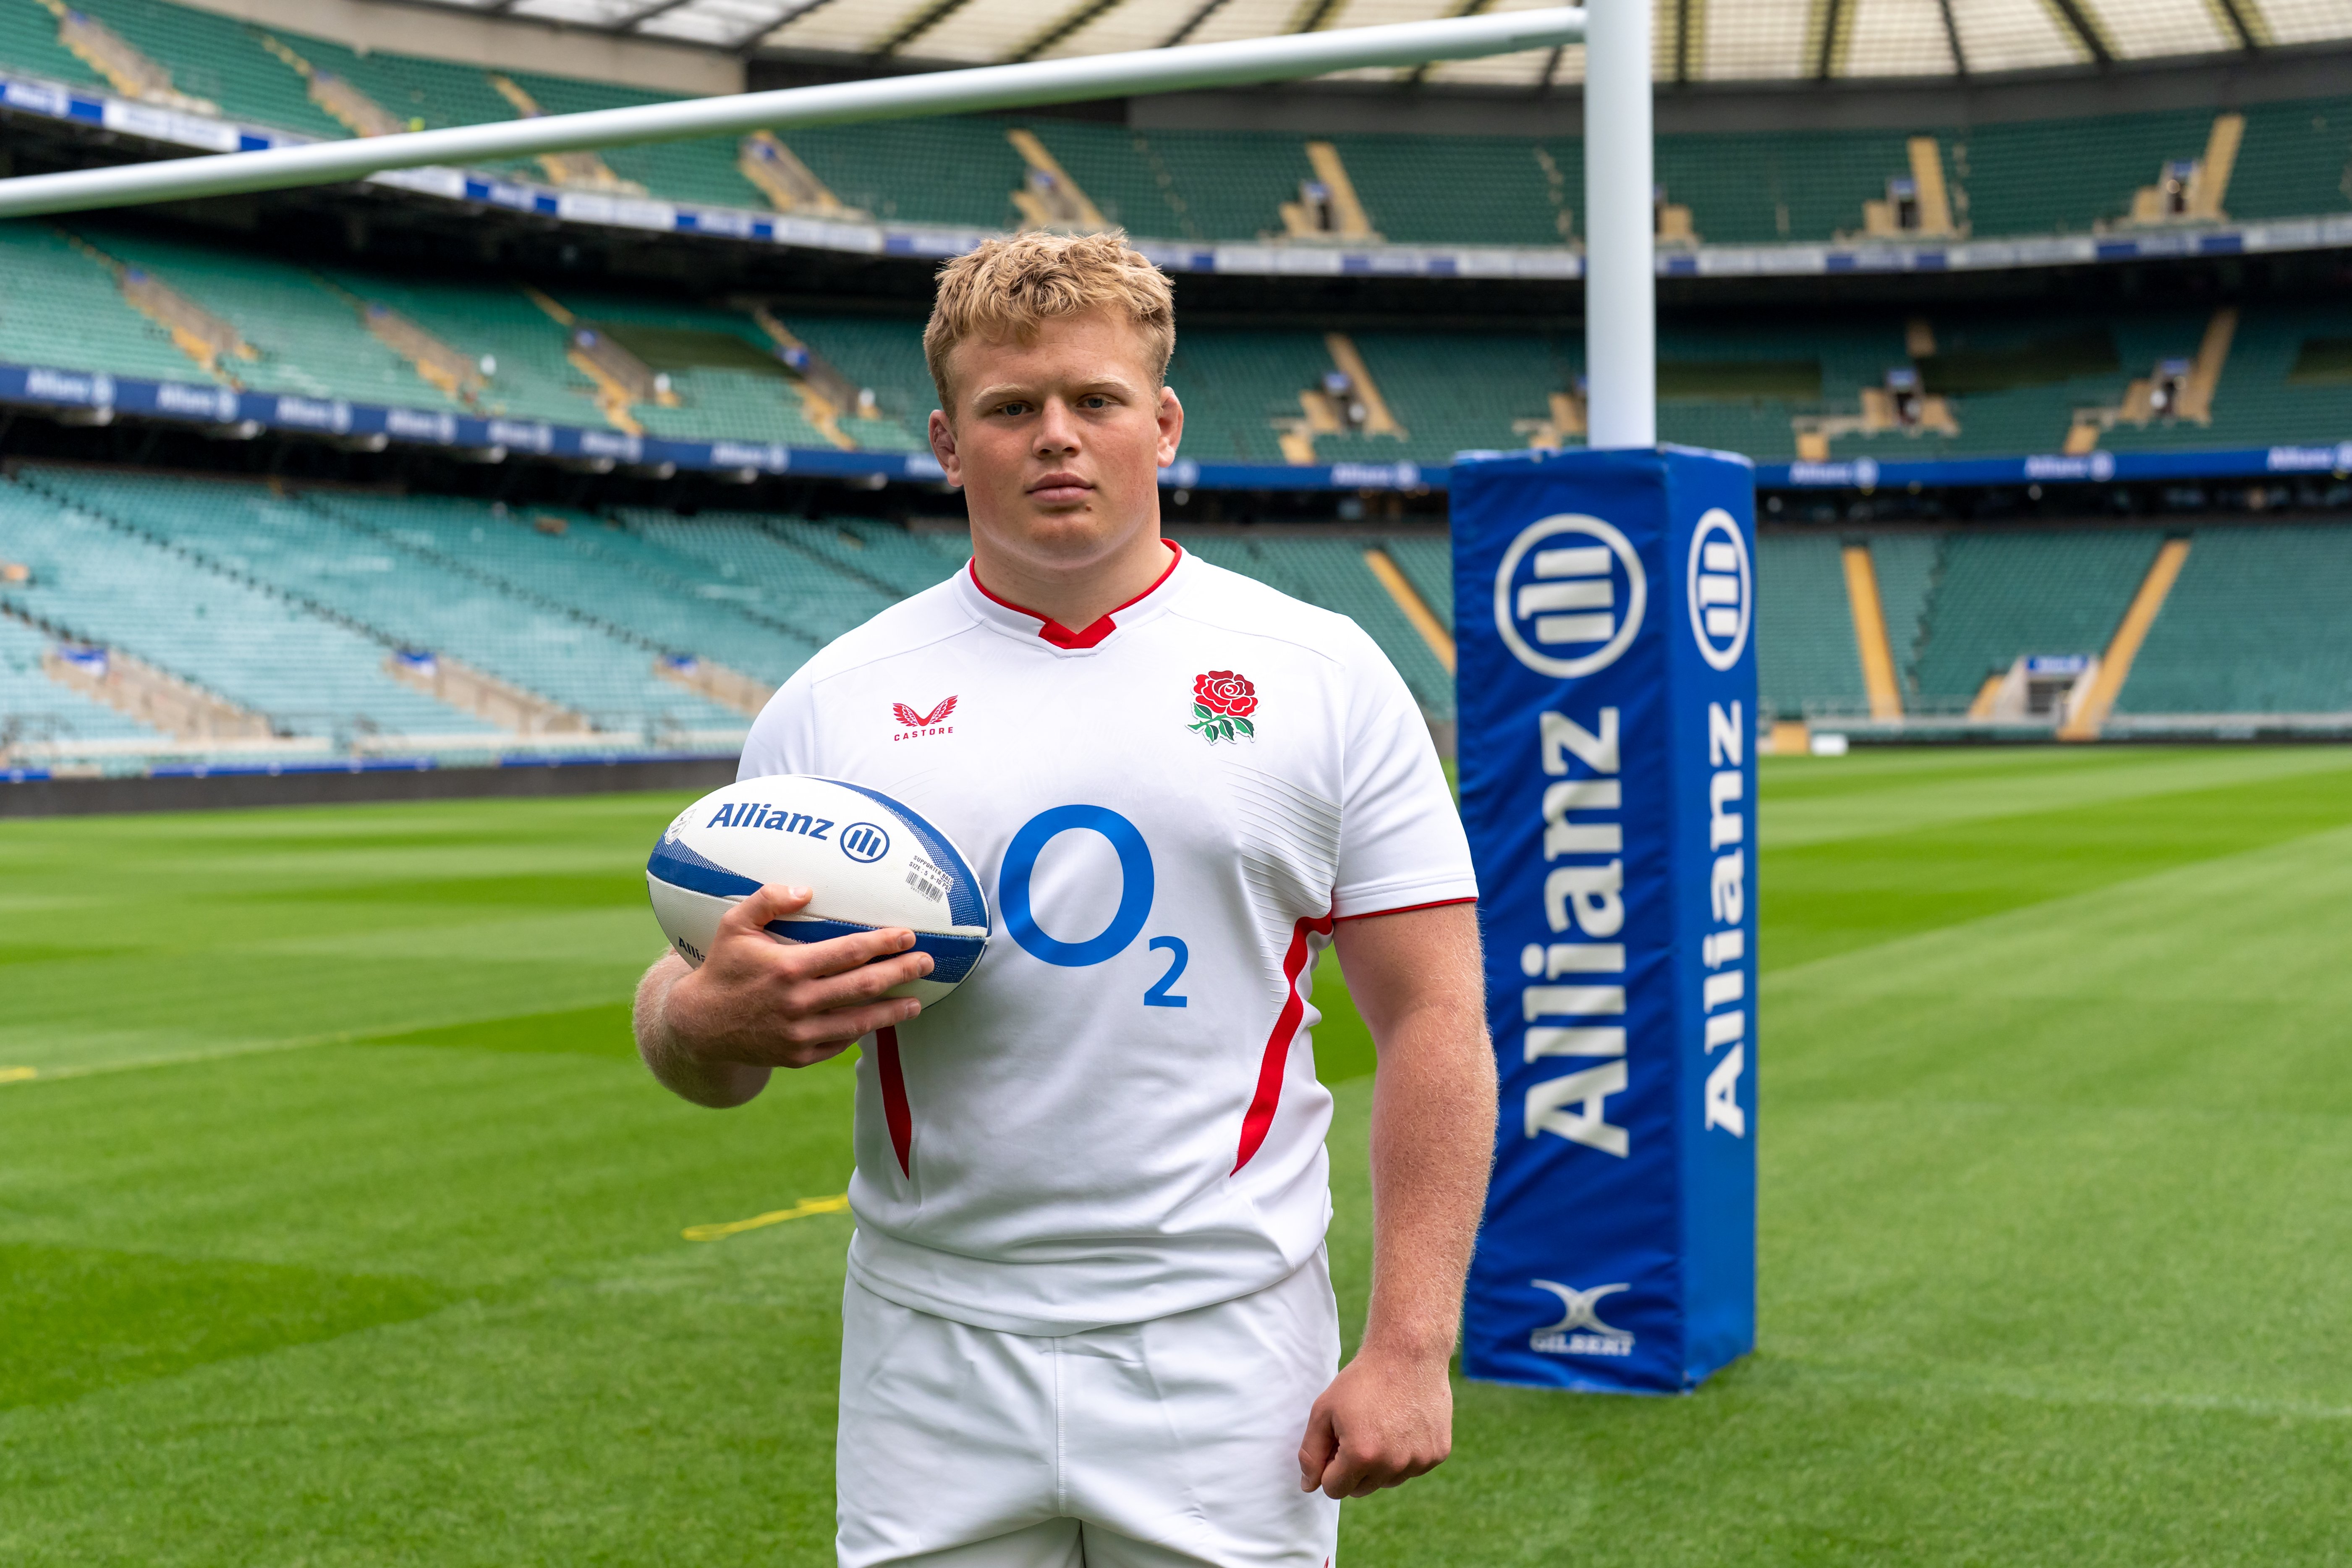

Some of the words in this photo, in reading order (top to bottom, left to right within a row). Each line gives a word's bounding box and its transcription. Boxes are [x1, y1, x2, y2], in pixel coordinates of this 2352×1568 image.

[894, 727, 953, 741] CASTORE
[706, 803, 835, 840] Allianz
[913, 855, 941, 875] SUPPORTER
[942, 873, 953, 884] BALL
[942, 882, 951, 892] PSI
[1520, 706, 1630, 1158] Allianz
[1703, 700, 1745, 1138] Allianz
